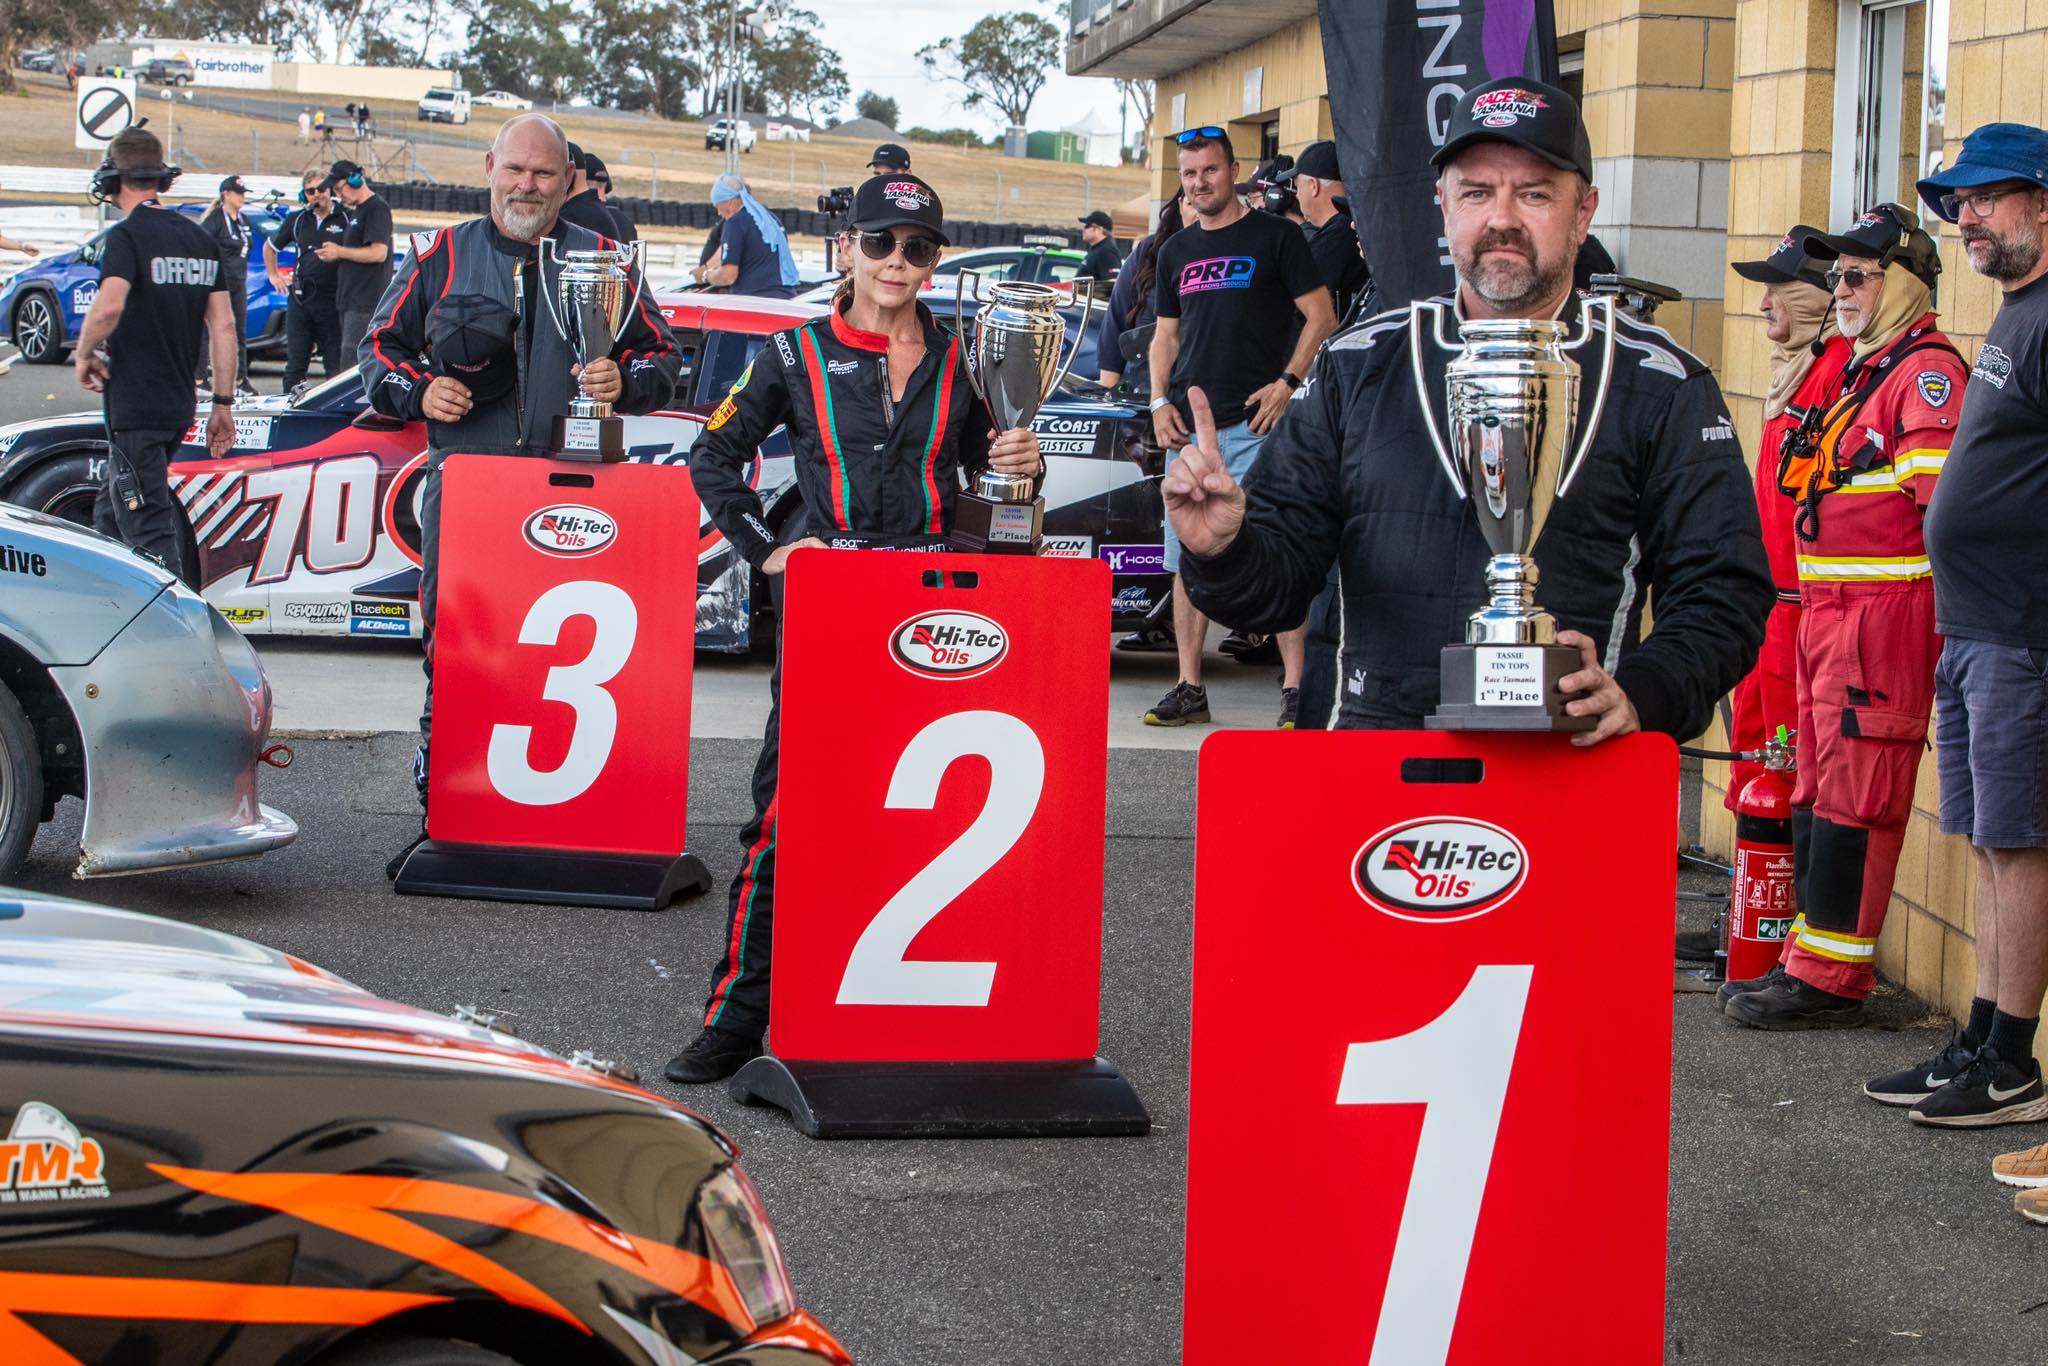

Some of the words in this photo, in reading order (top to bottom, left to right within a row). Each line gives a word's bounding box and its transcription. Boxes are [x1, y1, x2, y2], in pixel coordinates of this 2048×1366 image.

[195, 58, 264, 73] Fairbrother
[1472, 90, 1513, 109] RACE
[1474, 103, 1535, 117] TASMANIA
[885, 183, 916, 192] RACE
[887, 191, 929, 204] TASMANIA
[1182, 260, 1252, 286] PRP
[776, 332, 796, 366] sparco
[1049, 420, 1100, 433] COAST
[1702, 426, 1733, 441] PUMA
[246, 455, 379, 582] 70
[557, 516, 611, 534] Hi-Tec
[742, 512, 774, 543] sparco
[556, 533, 586, 547] Oils
[1004, 532, 1030, 540] Place
[0, 544, 47, 577] tive
[285, 602, 349, 618] REVOLUTION
[355, 604, 405, 615] Racetech
[357, 620, 406, 631] ACDelco
[933, 626, 1001, 648] Hi-Tec
[931, 648, 970, 665] Oils
[1491, 662, 1506, 670] TIN
[1507, 662, 1530, 670] TOPS
[487, 581, 637, 805] 3
[1480, 689, 1495, 701] 1st
[1499, 690, 1539, 701] Place
[836, 711, 1044, 1006] 2
[1417, 840, 1517, 871] Hi-Tec
[1415, 874, 1471, 898] Oils
[1336, 965, 1534, 1366] 1
[17, 1187, 59, 1201] MANN
[59, 1185, 110, 1200] RACING
